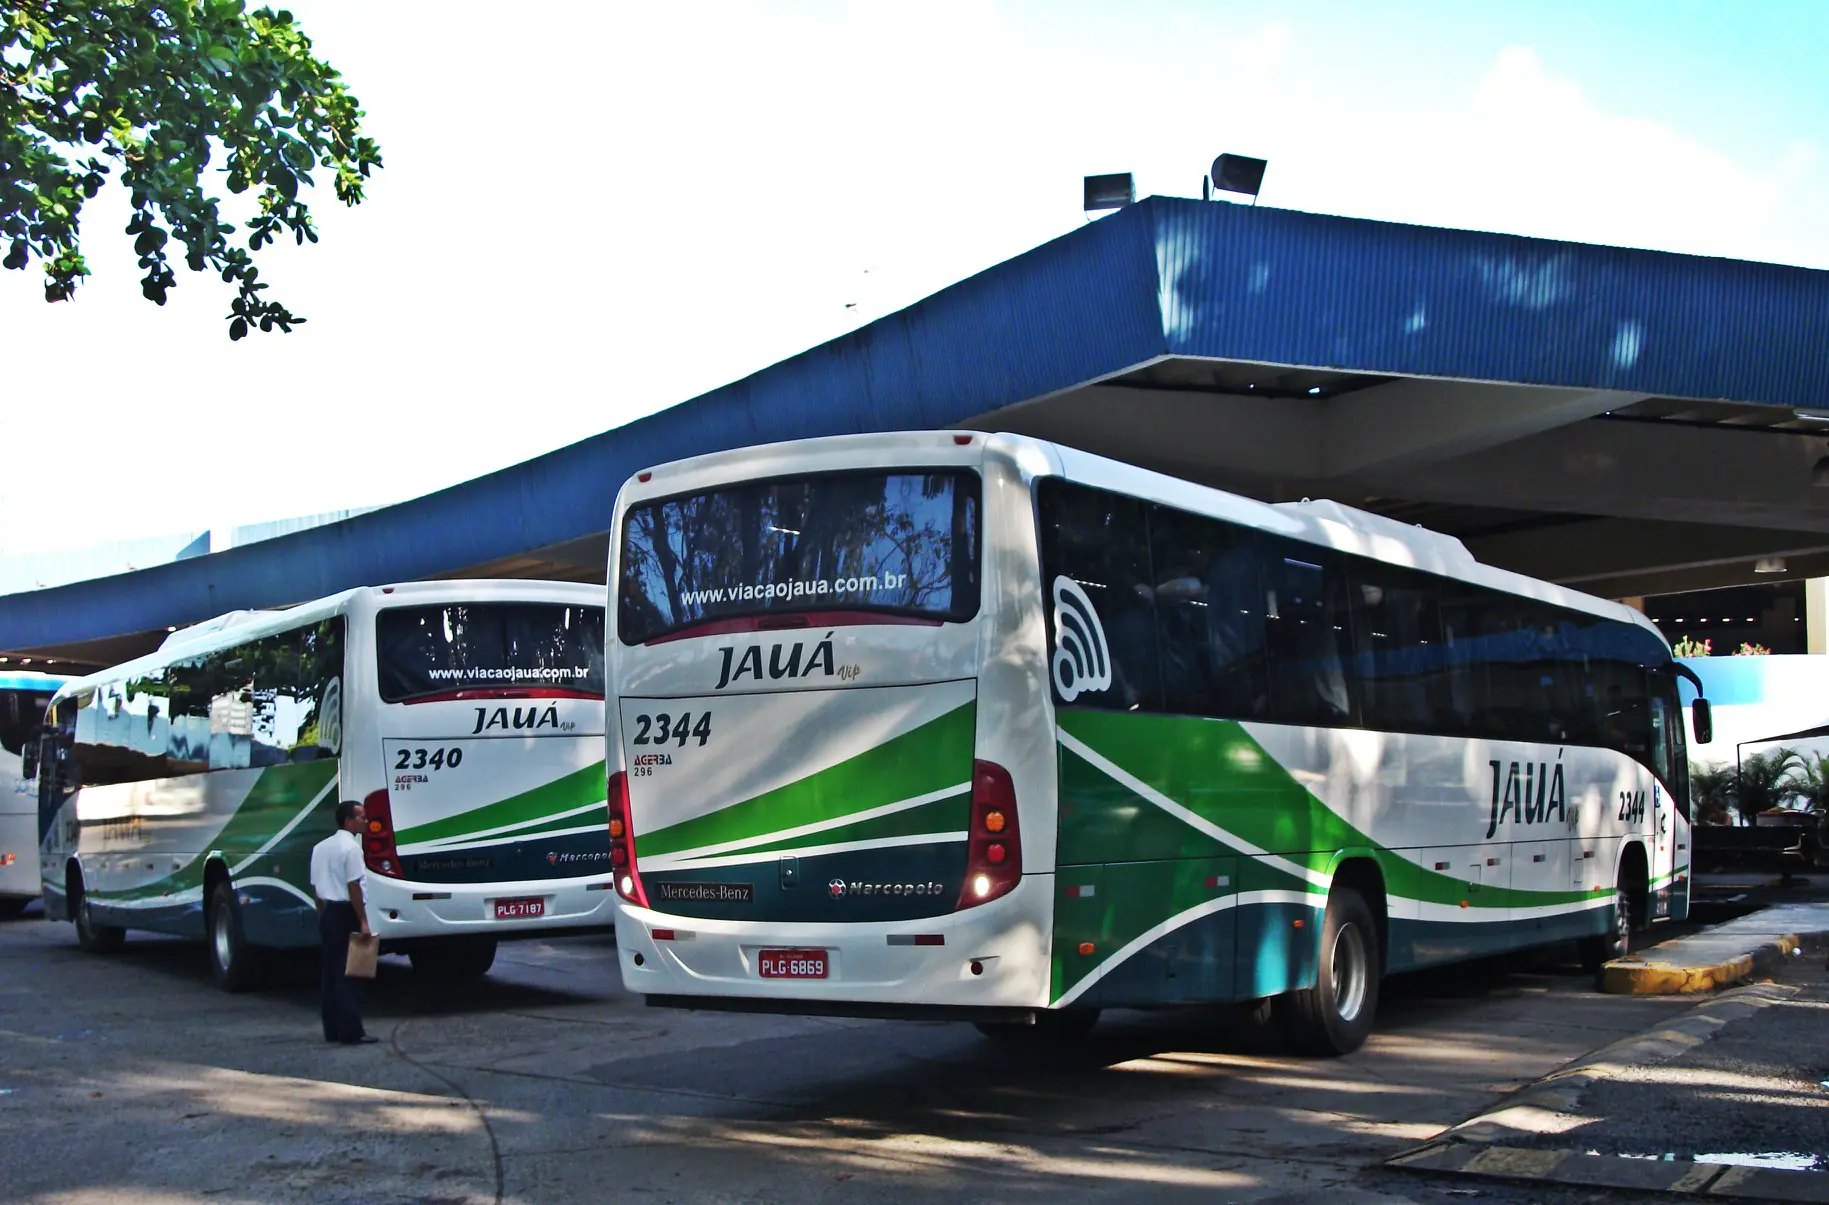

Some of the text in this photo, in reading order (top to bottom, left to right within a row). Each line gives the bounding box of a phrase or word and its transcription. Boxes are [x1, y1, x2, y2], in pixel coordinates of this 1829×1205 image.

[681, 570, 907, 606] www.viacaojaua.com.br
[428, 665, 589, 682] www.viacaojaua.com.br
[714, 631, 835, 690] JAUÁ
[471, 701, 559, 734] JAUÁ
[633, 711, 712, 748] 2344
[394, 747, 463, 771] 2340
[634, 766, 653, 777] 296
[1486, 747, 1566, 840] JAUÁ
[1618, 790, 1646, 824] 2344
[559, 851, 611, 862] Marcopol
[660, 883, 749, 900] Mercedes-Benz
[849, 880, 945, 896] Marcopolo
